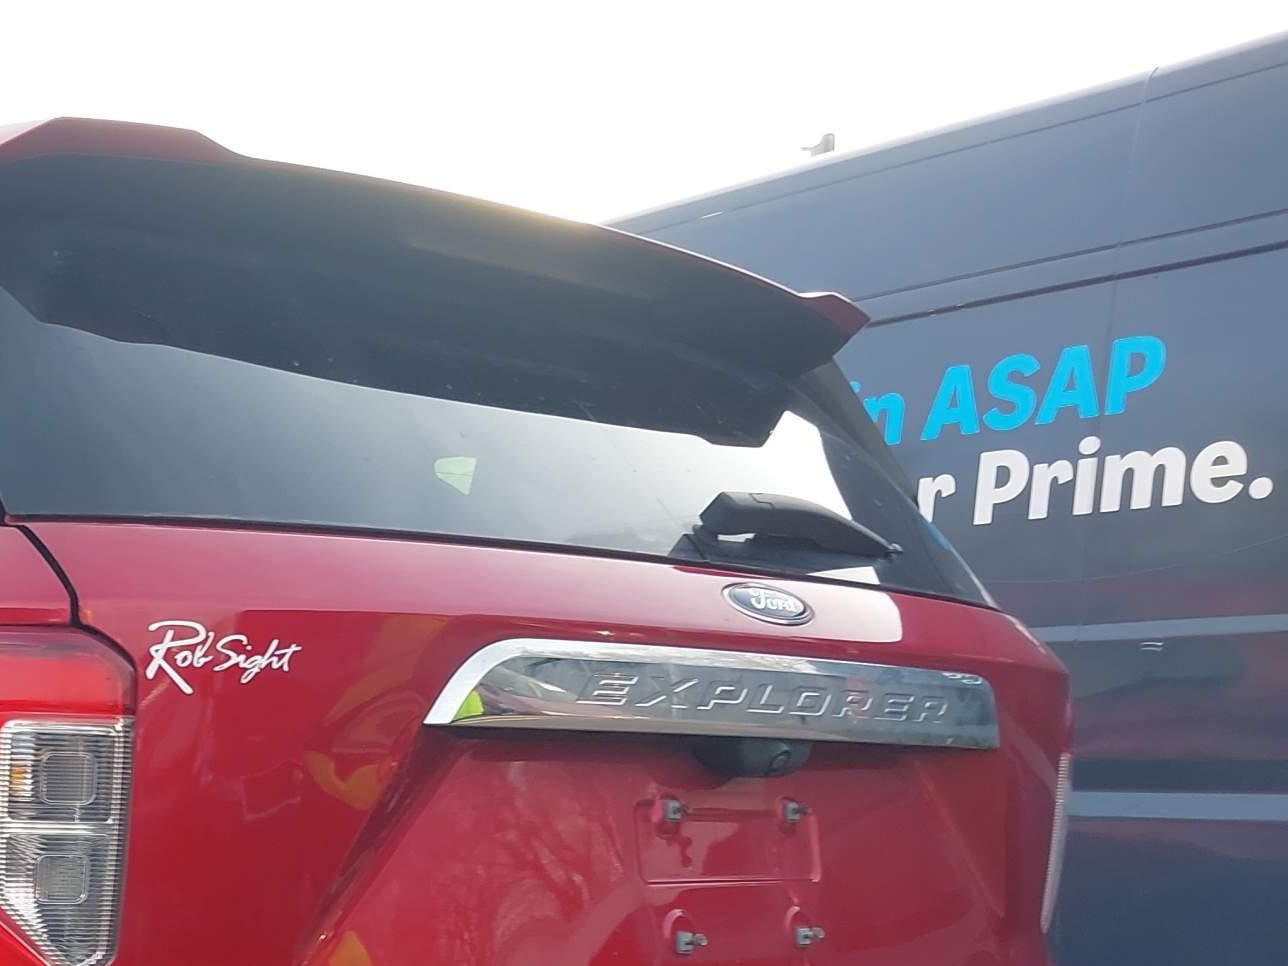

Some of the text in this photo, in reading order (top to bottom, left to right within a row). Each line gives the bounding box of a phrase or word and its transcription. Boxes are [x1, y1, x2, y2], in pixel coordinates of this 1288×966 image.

[920, 336, 1167, 441] ASAP
[973, 436, 1274, 525] Prime.
[750, 590, 803, 613] Ford
[145, 620, 303, 695] Rob Sight
[576, 672, 949, 724] EXPLORER
